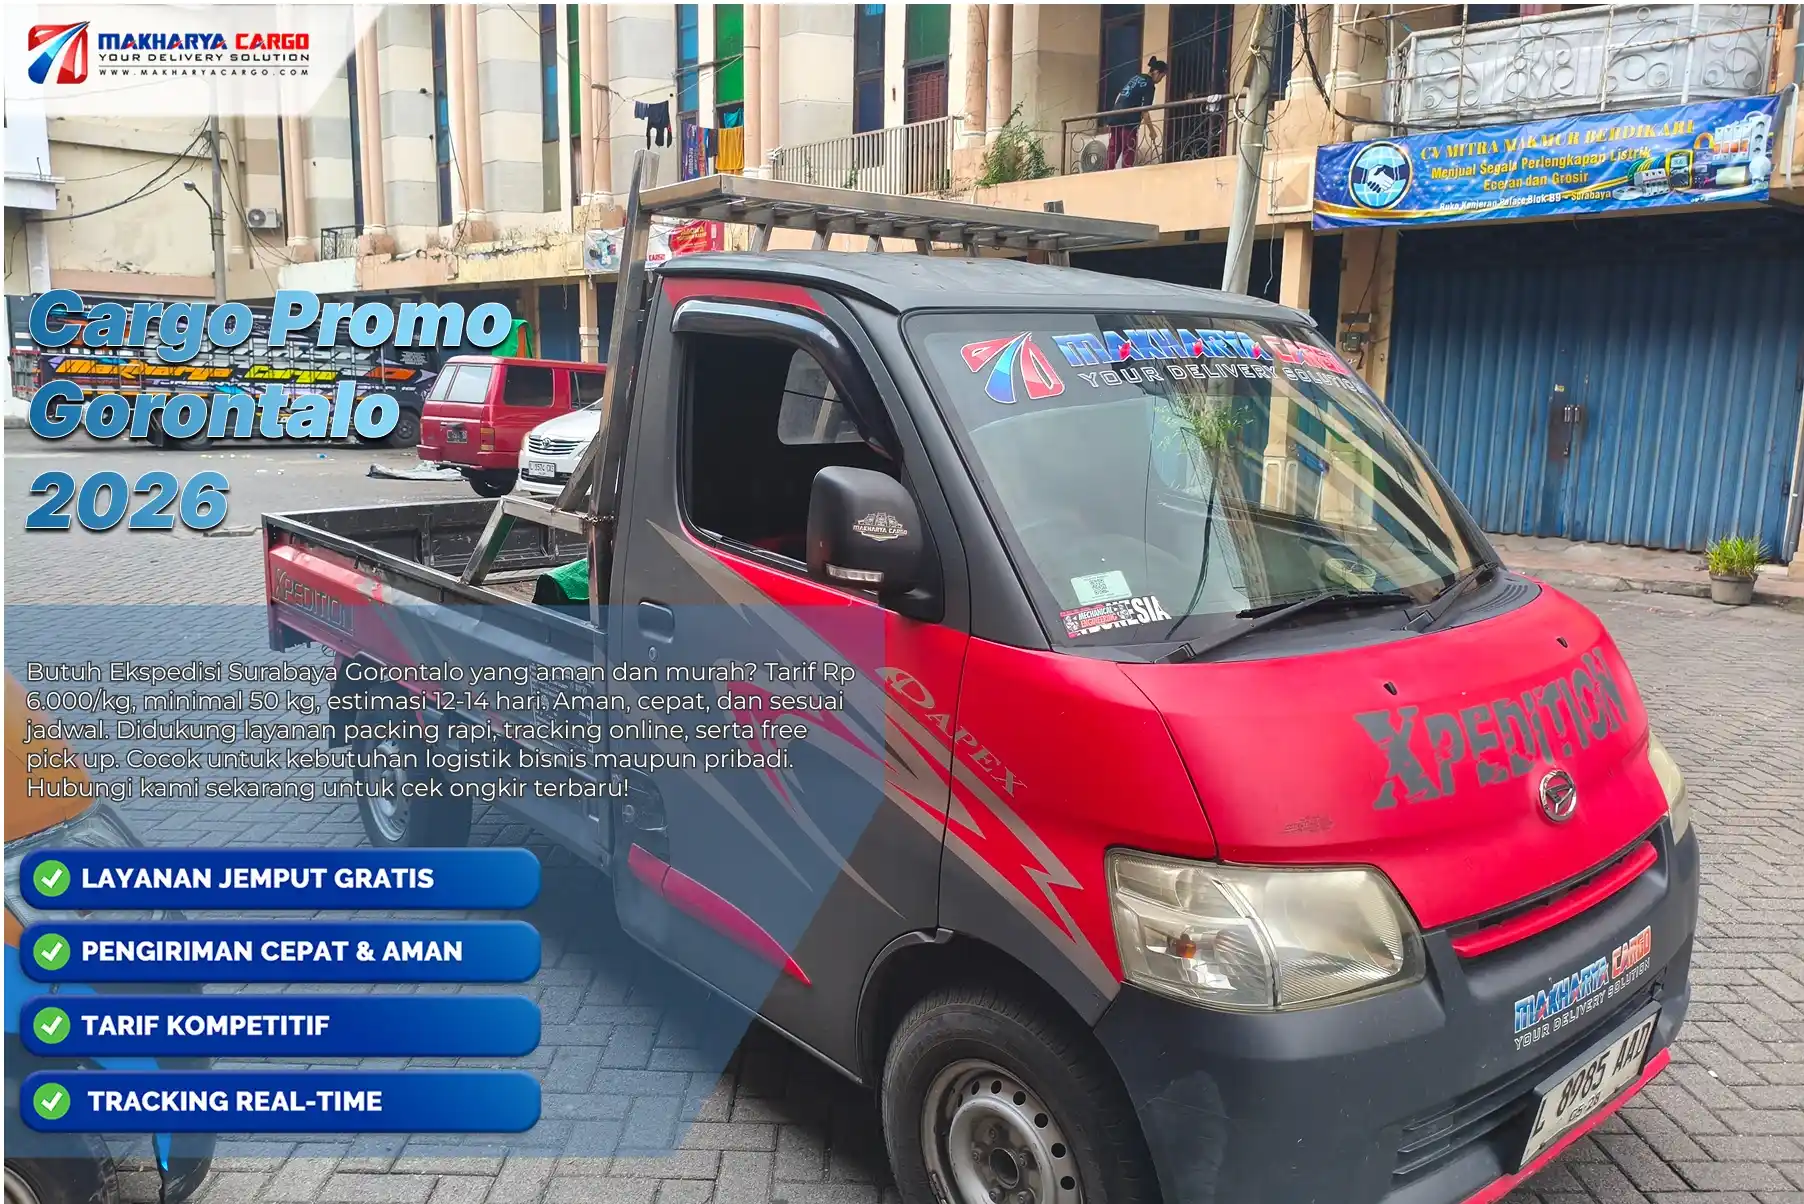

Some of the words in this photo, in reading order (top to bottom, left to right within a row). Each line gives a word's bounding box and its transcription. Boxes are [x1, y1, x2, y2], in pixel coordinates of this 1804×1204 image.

[1431, 163, 1476, 180] Menjual
[1479, 157, 1518, 176] Segala
[1521, 152, 1607, 170] Perlengkapan
[1610, 145, 1652, 162] Listrik
[1445, 140, 1499, 158] MITRA
[1483, 177, 1523, 192] Eceran
[1525, 174, 1548, 188] dan
[1551, 170, 1589, 185] Grosir
[1051, 328, 1273, 368] MAKHARYA
[1077, 365, 1165, 388] YOUR
[1168, 363, 1280, 380] DELIVERY
[1514, 956, 1609, 1033] MAKHARYA
[1611, 925, 1651, 979] CARGO
[1514, 1023, 1550, 1050] YOUR
[1553, 990, 1606, 1031] DELIVERY
[1607, 957, 1650, 999] SOLUTION
[1532, 1099, 1547, 1138] L
[1612, 1021, 1651, 1076] AAD
